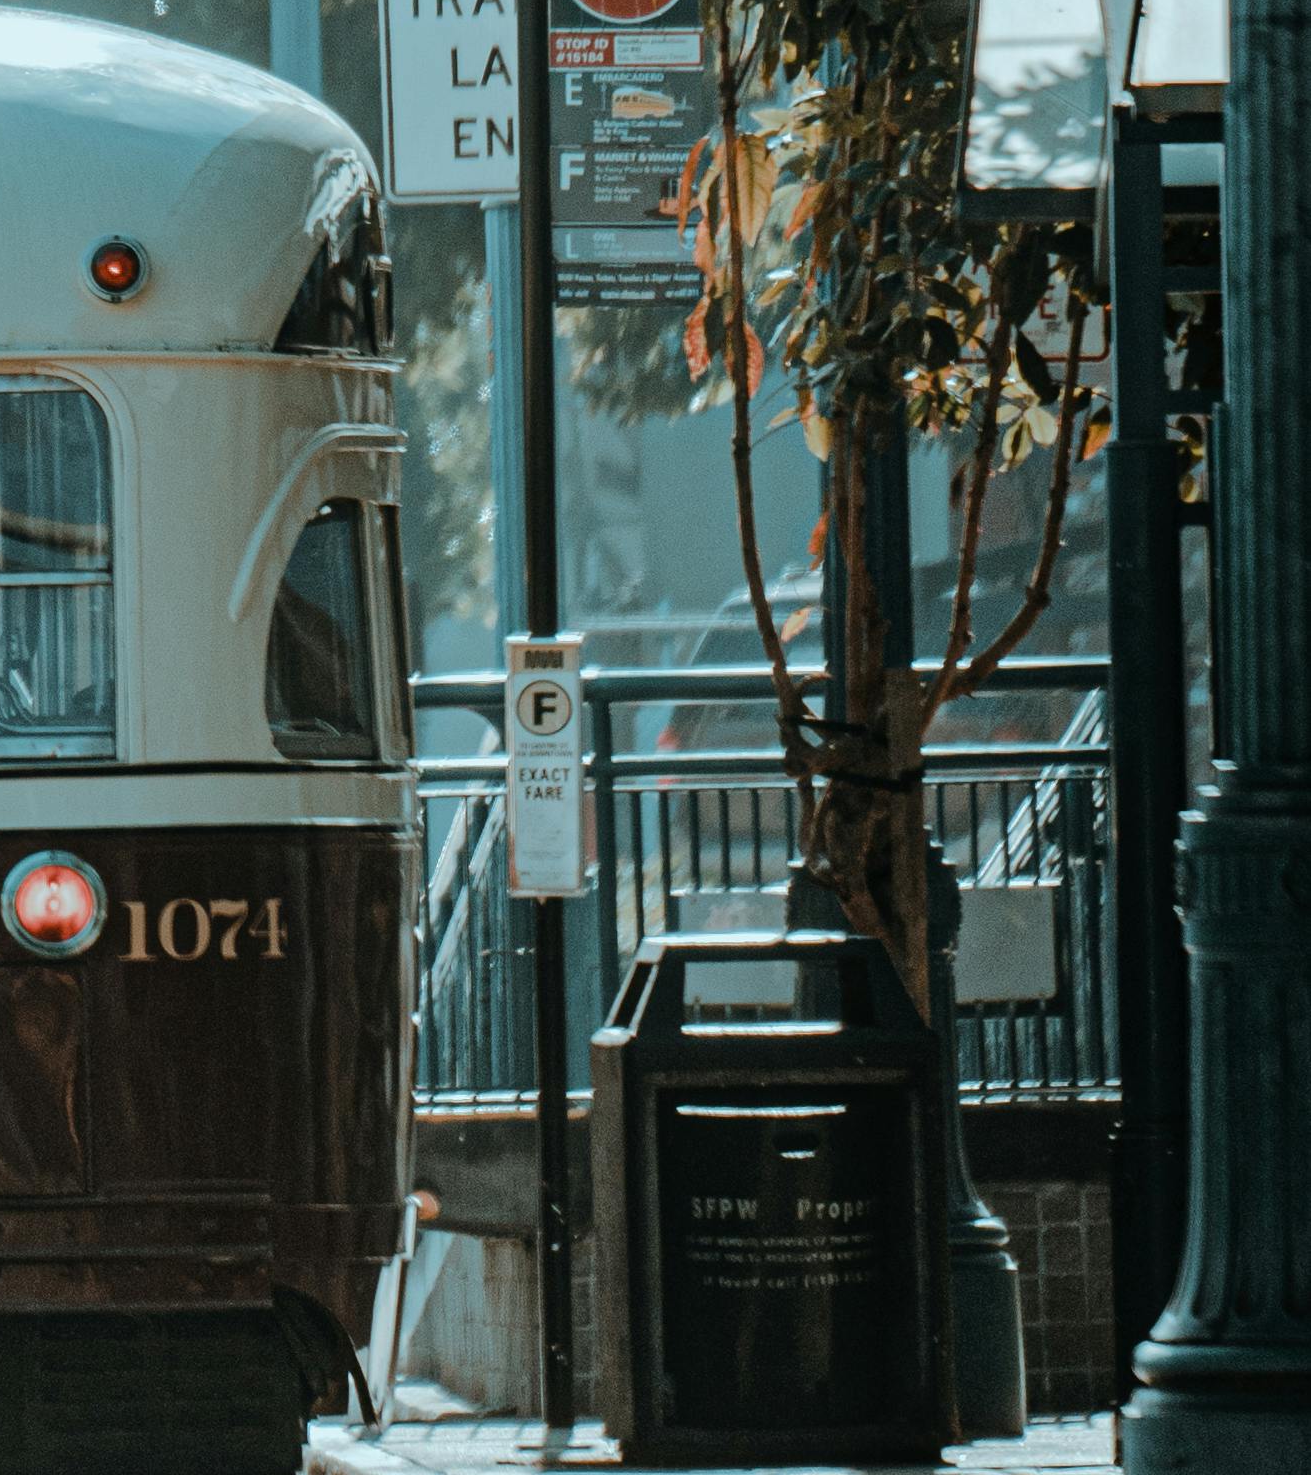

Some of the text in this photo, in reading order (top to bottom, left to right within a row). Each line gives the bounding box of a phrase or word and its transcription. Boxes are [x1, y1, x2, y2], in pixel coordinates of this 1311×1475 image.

[556, 37, 609, 50] STOP ID
[451, 44, 513, 88] LA
[565, 73, 583, 106] E
[453, 116, 515, 159] EN
[560, 153, 586, 190] F
[565, 233, 579, 259] L
[534, 692, 557, 726] F
[519, 768, 571, 783] EXACT
[524, 786, 564, 801] FARE
[117, 898, 289, 962] 1074
[691, 1196, 758, 1220] SFPW
